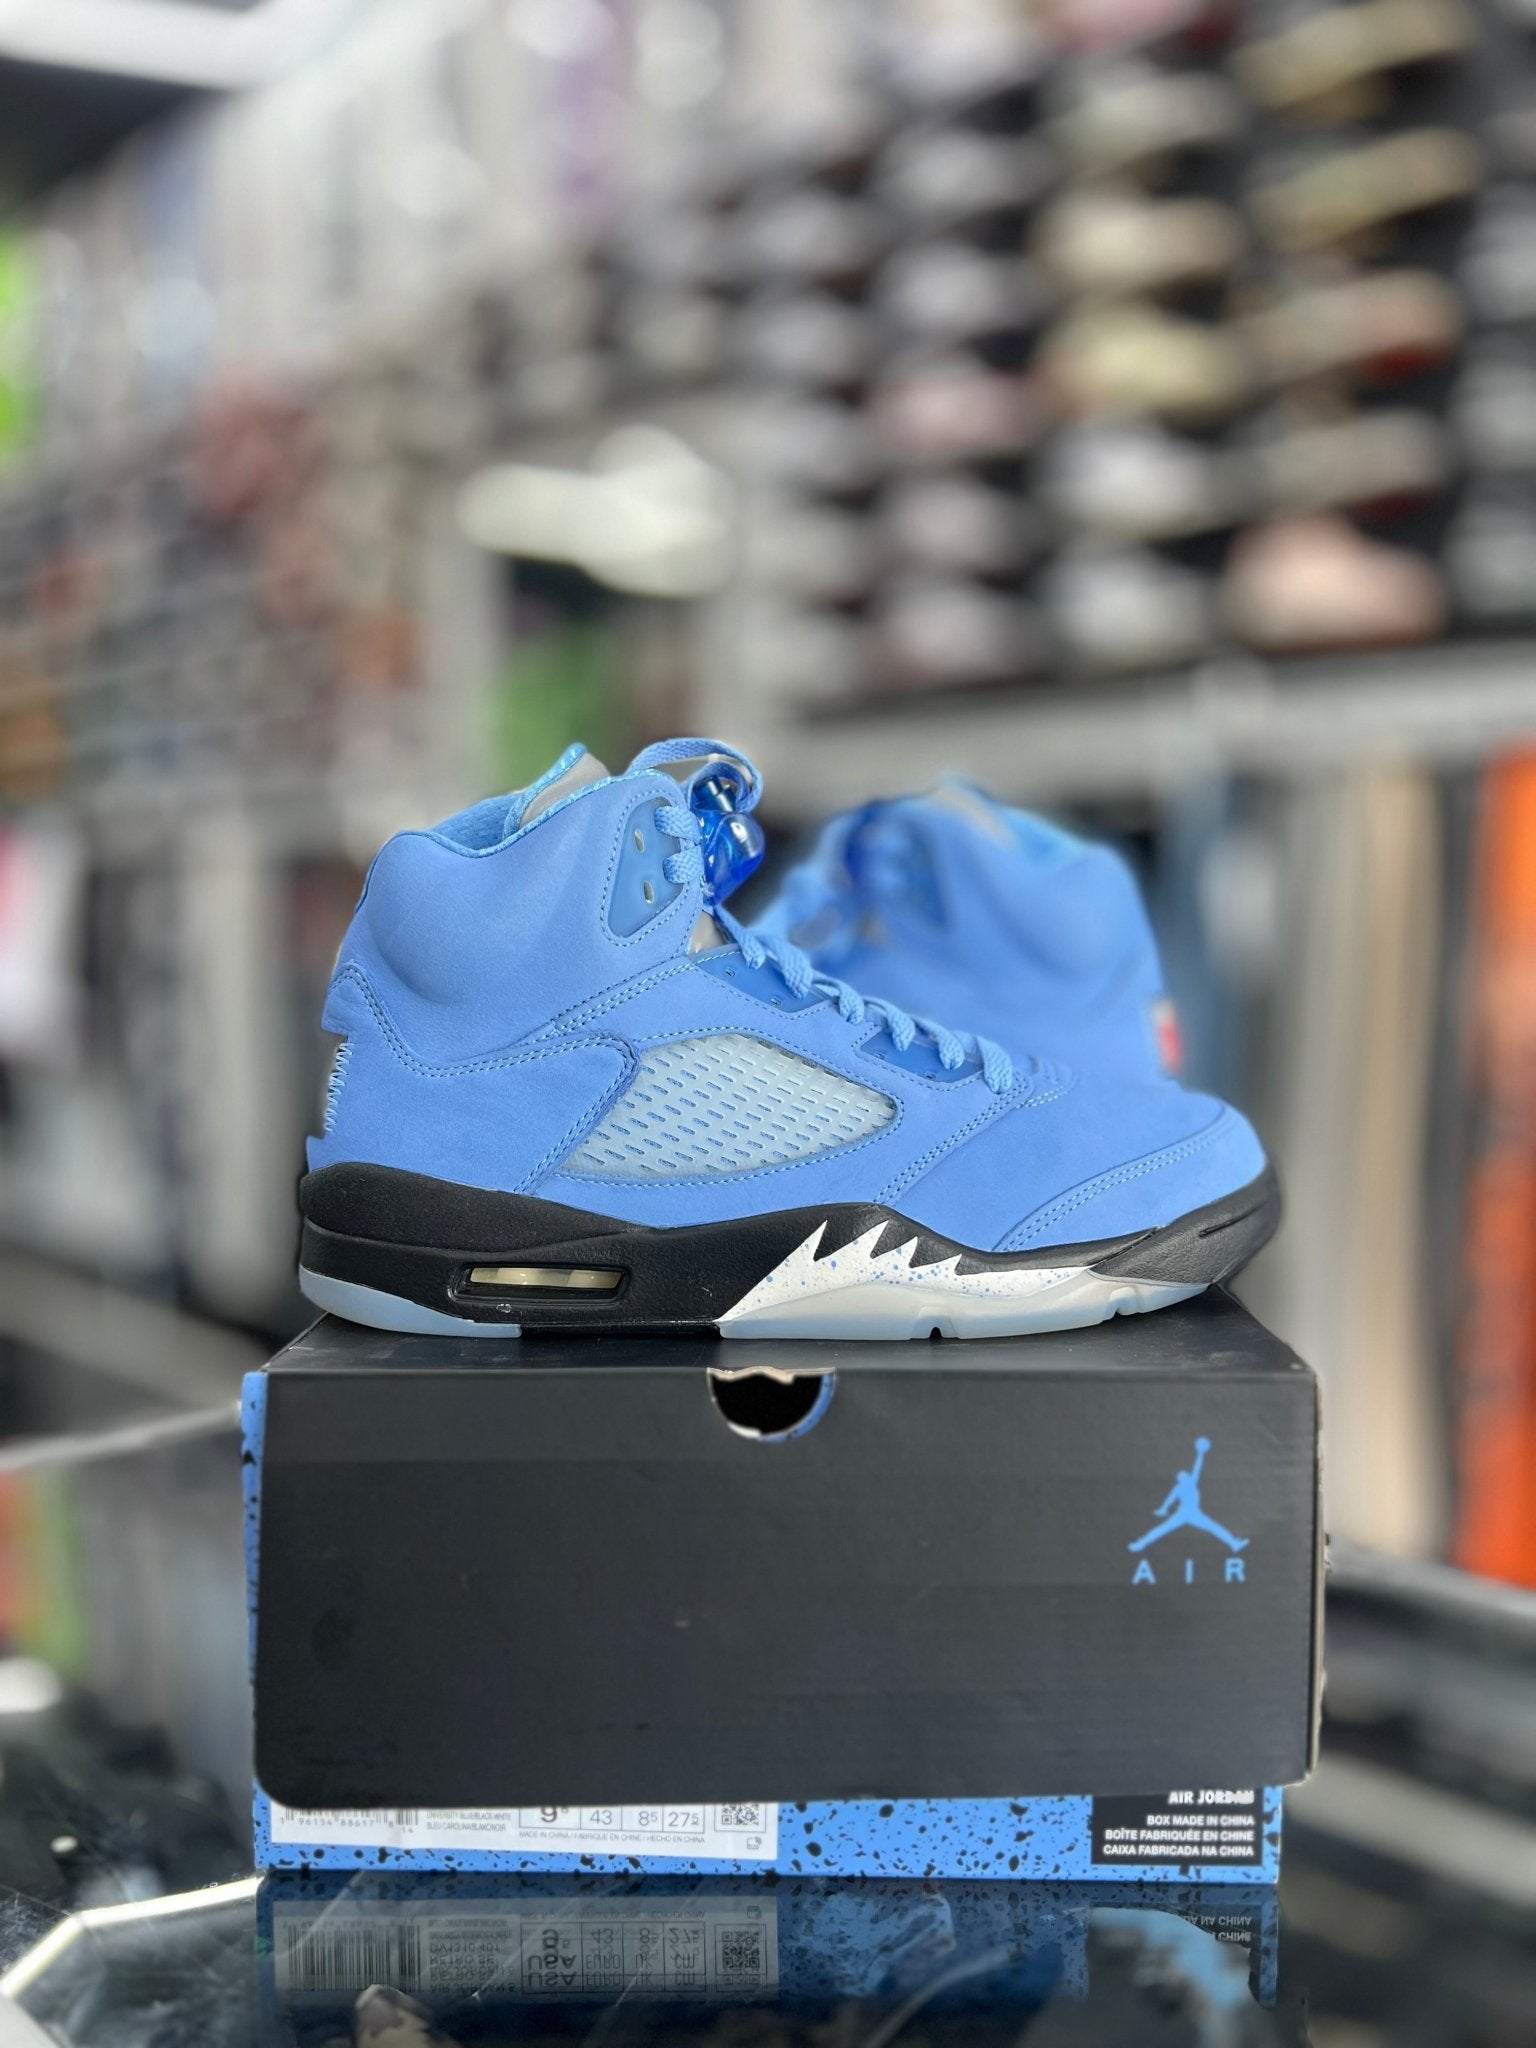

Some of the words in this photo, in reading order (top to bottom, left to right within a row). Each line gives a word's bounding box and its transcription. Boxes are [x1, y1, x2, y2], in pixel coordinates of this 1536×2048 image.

[1131, 1557, 1246, 1585] AIR
[1168, 1790, 1194, 1805] AIR
[590, 1810, 612, 1826] 43
[1147, 1815, 1170, 1826] BOX
[1173, 1815, 1203, 1826] MADE
[1206, 1815, 1218, 1826] IN
[1220, 1815, 1254, 1826] CHINA
[520, 1831, 540, 1839] MADE
[1105, 1828, 1138, 1840] BOÎTE
[1140, 1828, 1201, 1842] FABRIQUÉE
[1203, 1831, 1218, 1841] EN
[1220, 1831, 1254, 1841] CHINE
[1103, 1844, 1137, 1855] CAIXA
[1138, 1845, 1200, 1856] FABRICADA
[1202, 1846, 1217, 1856] NA
[1219, 1846, 1254, 1856] CHINA
